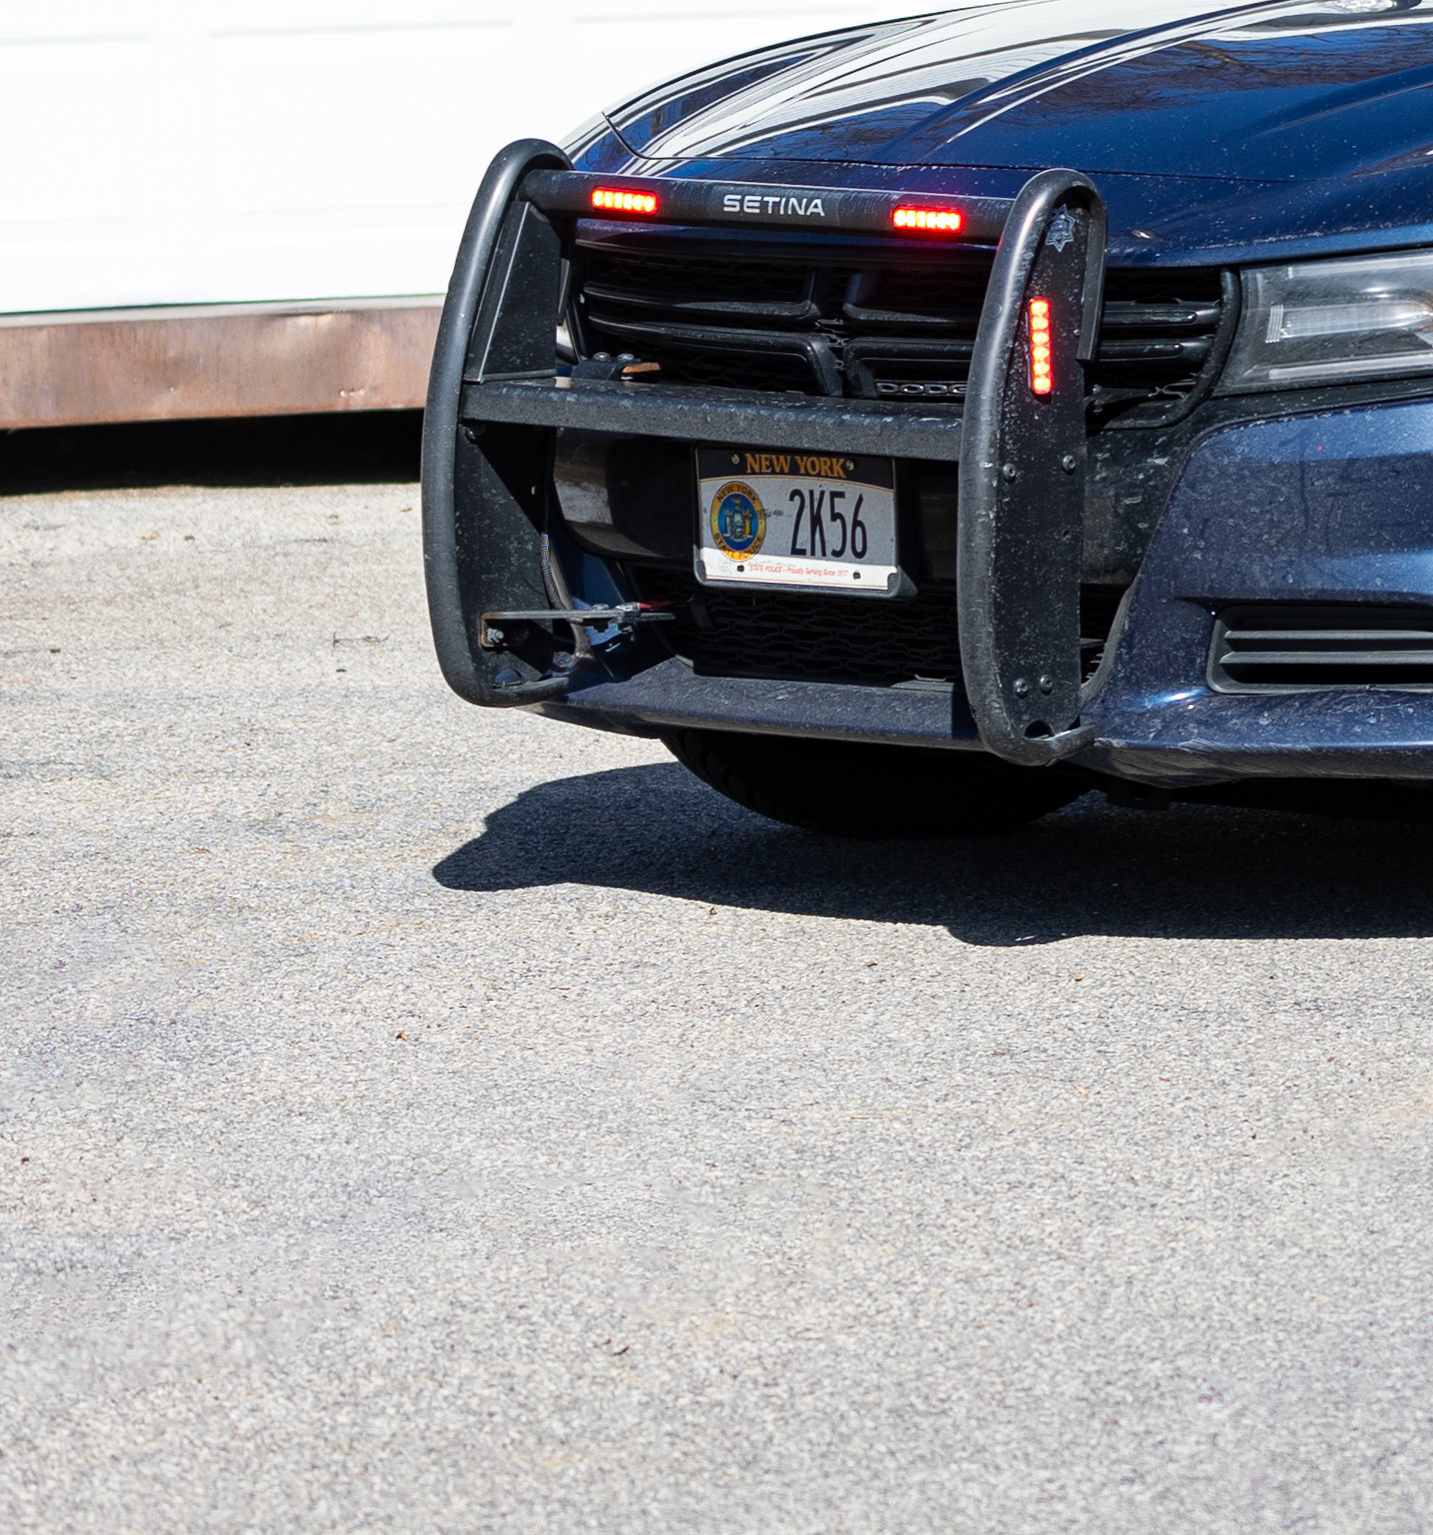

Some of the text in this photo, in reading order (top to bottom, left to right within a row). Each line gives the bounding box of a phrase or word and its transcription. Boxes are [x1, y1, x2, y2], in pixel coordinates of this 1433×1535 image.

[723, 194, 825, 217] SETINA
[876, 382, 967, 394] DODG
[745, 453, 848, 478] NEW YORK
[788, 488, 868, 560] 2K56
